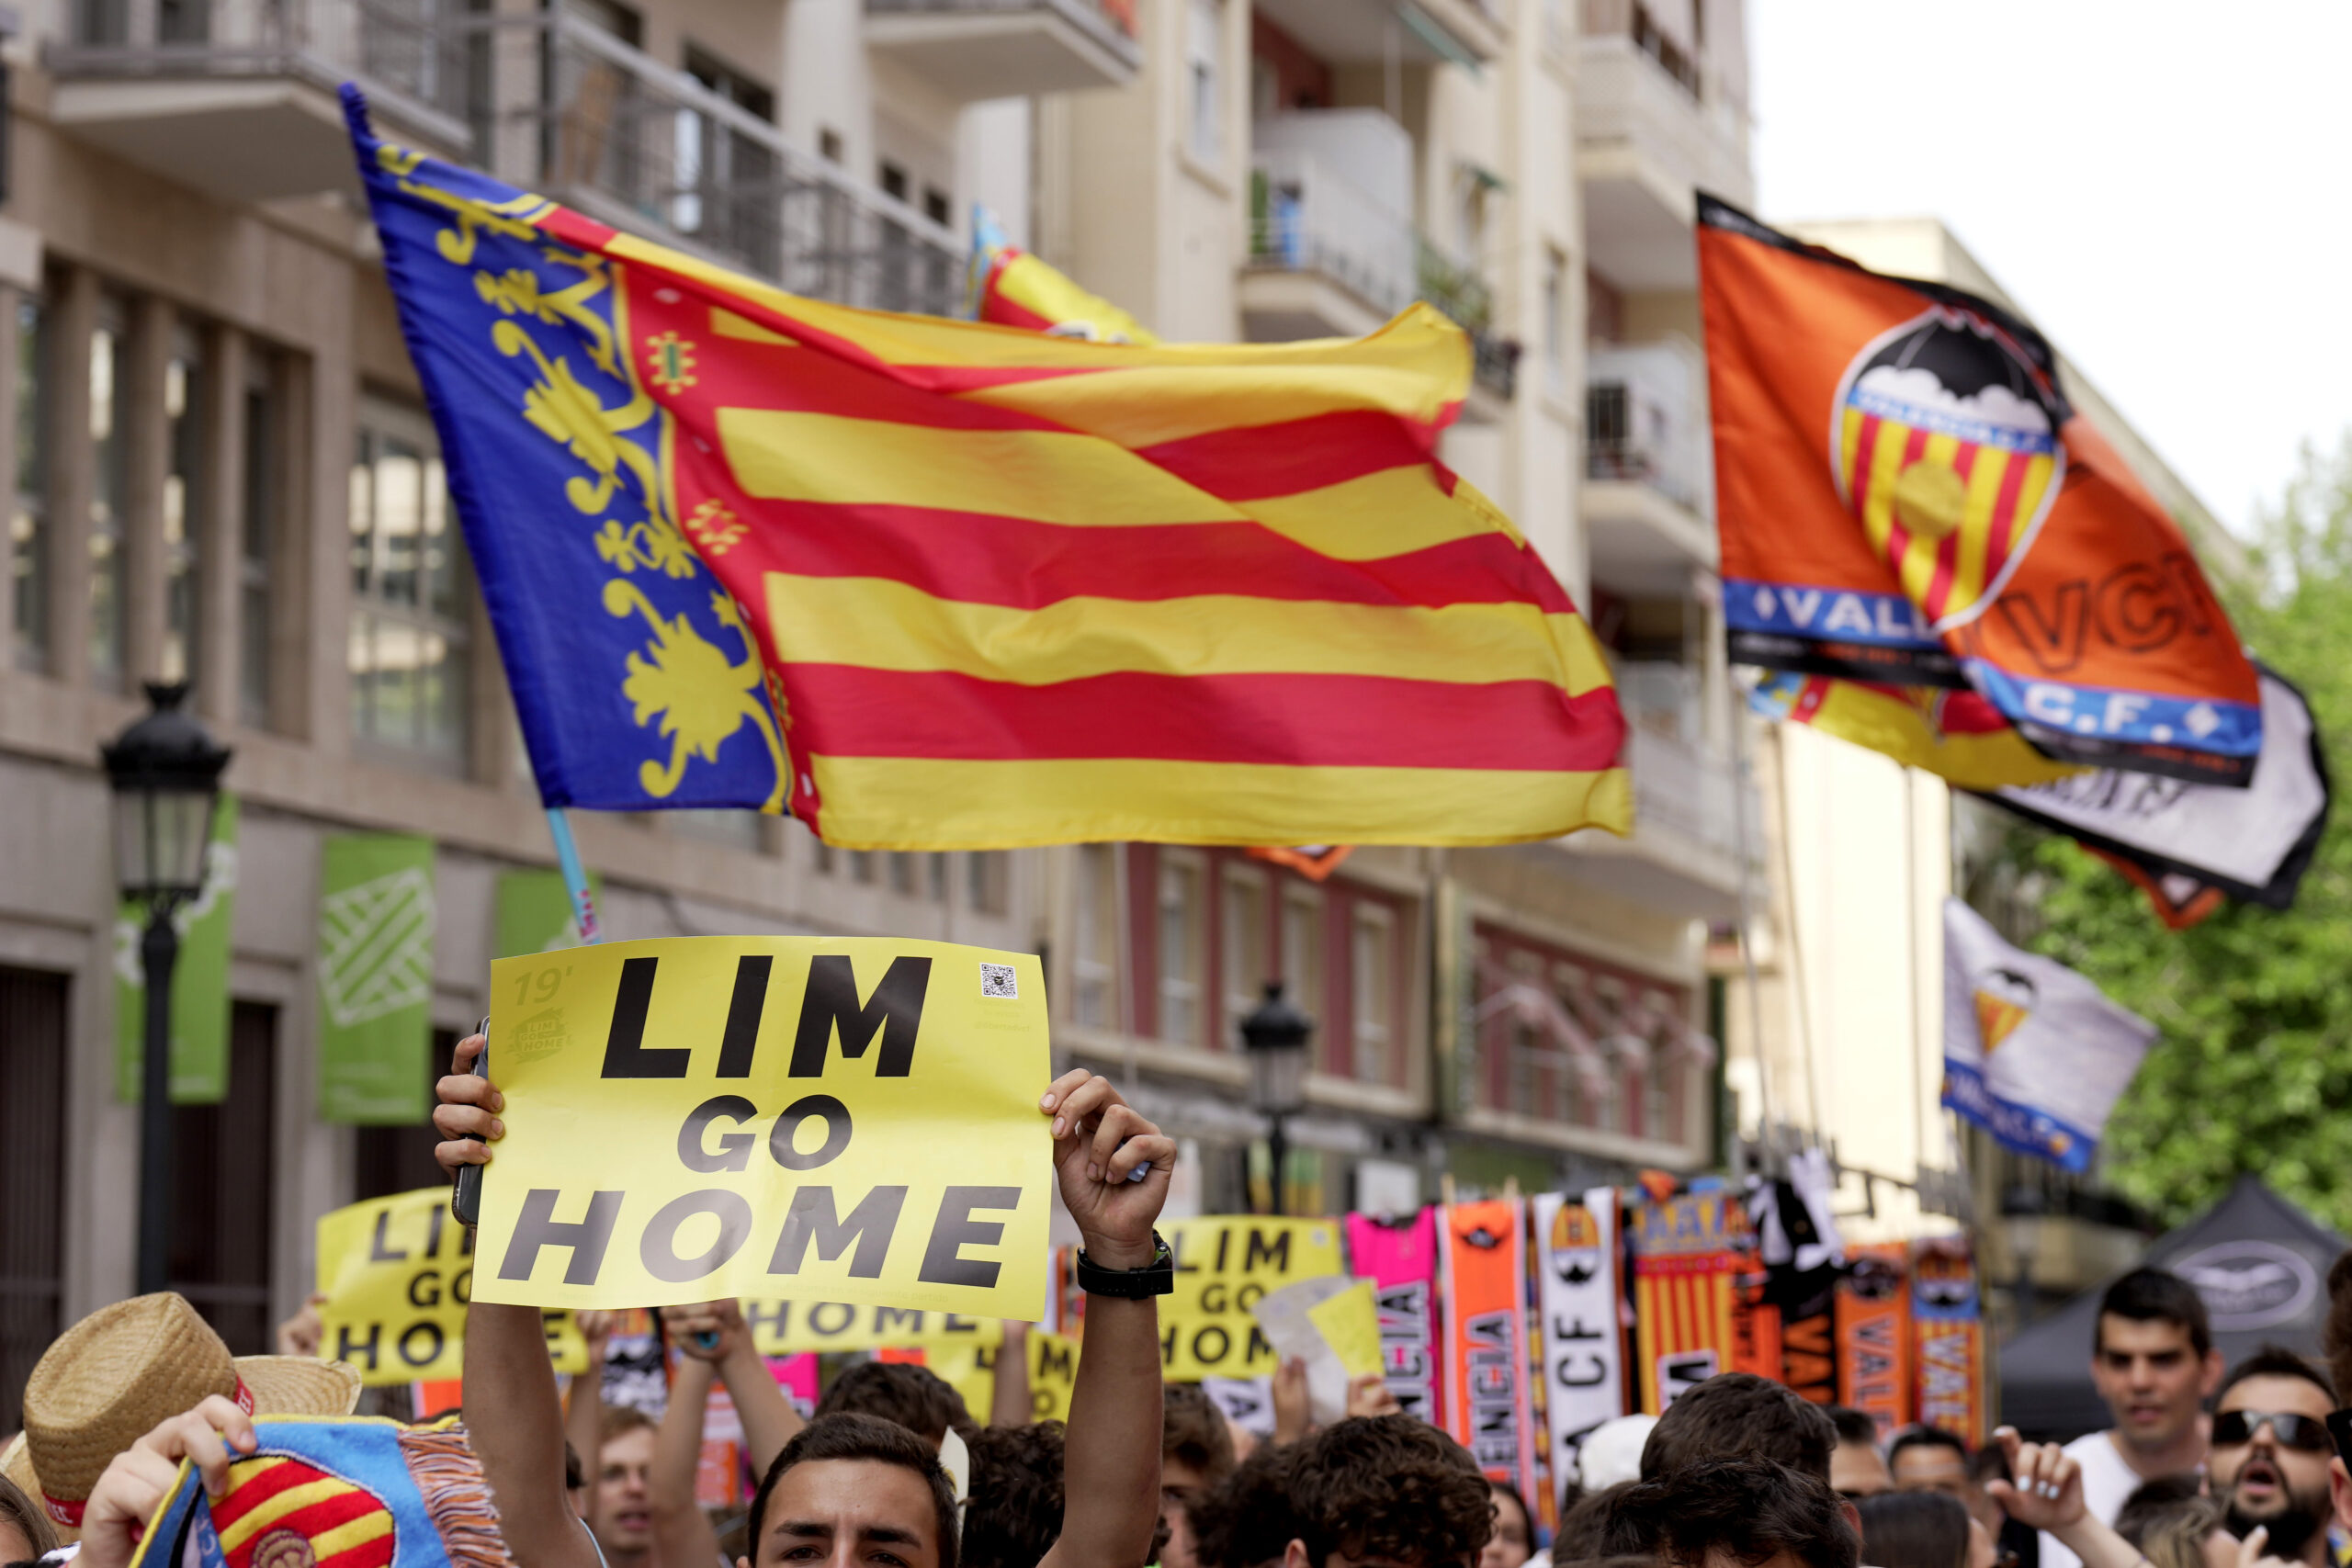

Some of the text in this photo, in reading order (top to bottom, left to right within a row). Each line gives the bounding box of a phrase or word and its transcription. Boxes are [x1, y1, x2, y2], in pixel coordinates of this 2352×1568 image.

[1781, 585, 1933, 640] VAL
[601, 954, 933, 1079] LIM
[677, 1094, 853, 1174] GO
[369, 1202, 474, 1262] LI
[497, 1185, 1023, 1289] HOME
[1170, 1228, 1293, 1273] LIM
